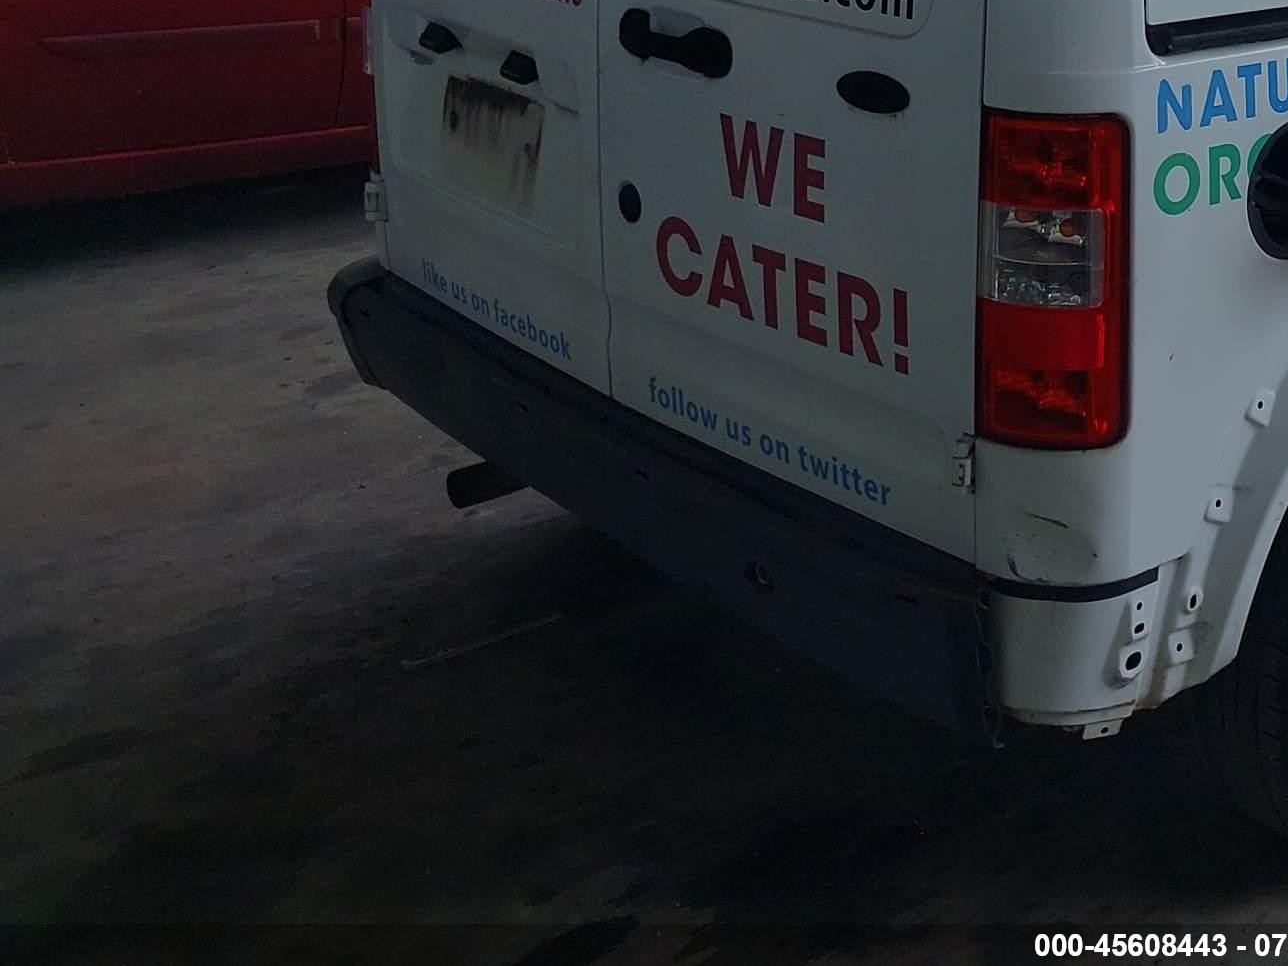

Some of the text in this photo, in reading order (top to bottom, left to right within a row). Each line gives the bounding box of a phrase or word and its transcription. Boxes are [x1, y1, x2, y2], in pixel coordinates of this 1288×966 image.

[720, 112, 826, 223] WE
[421, 259, 573, 361] like us on facebook
[656, 216, 910, 375] CATER!
[648, 377, 892, 507] follow us on twitter
